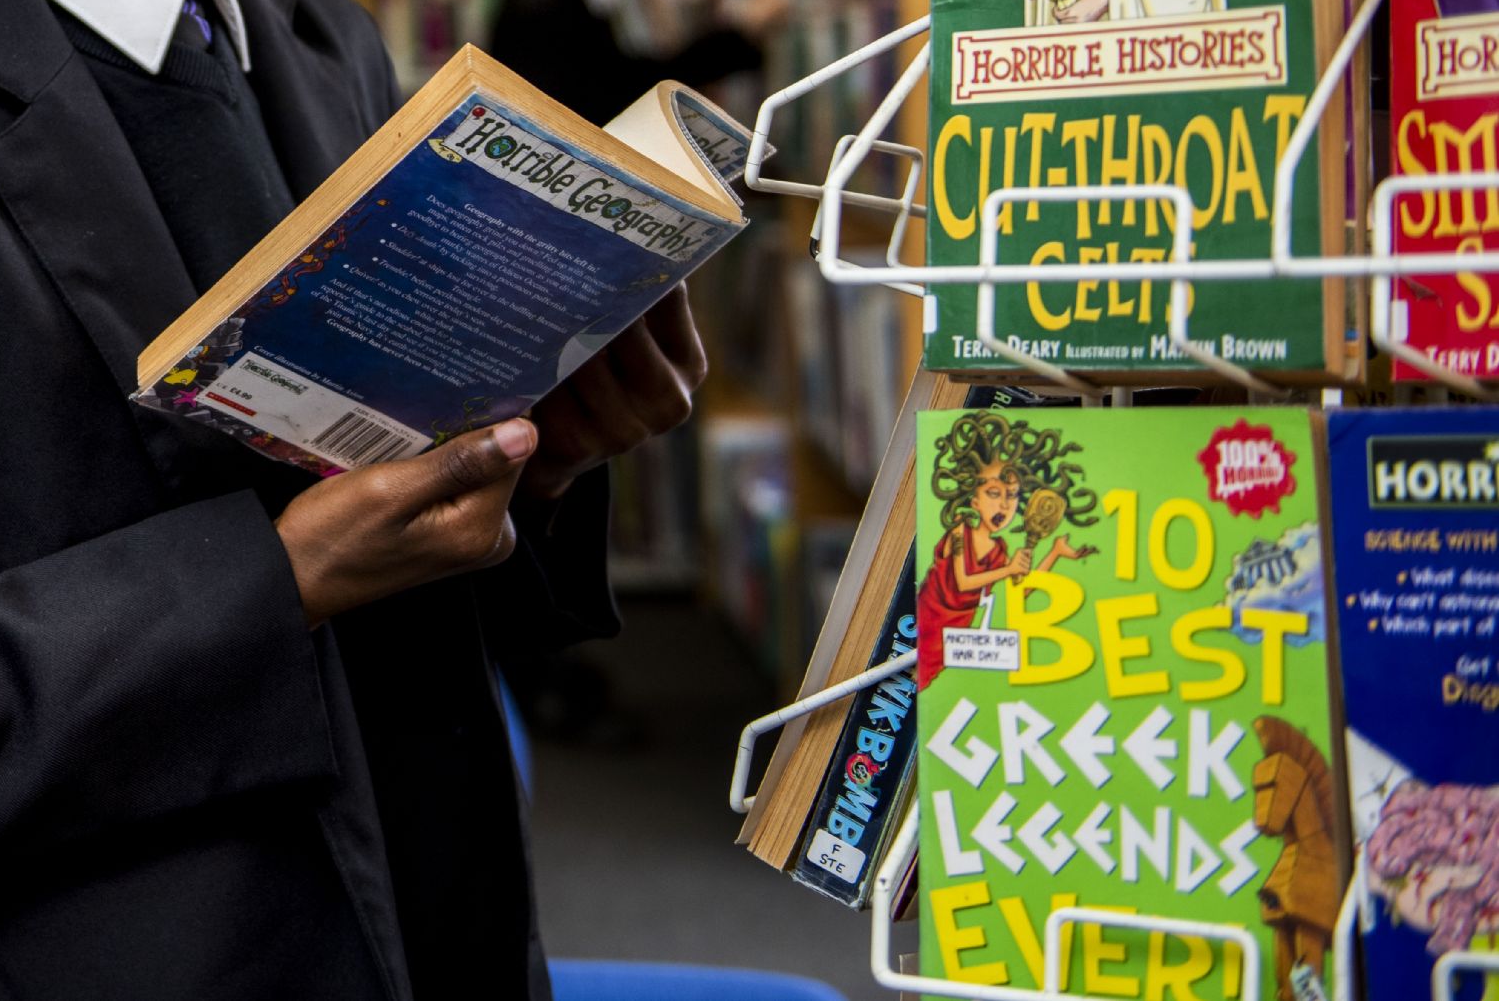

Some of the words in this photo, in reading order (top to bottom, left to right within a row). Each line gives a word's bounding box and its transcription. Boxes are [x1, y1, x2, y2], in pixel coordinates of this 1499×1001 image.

[971, 42, 1103, 84] HORRIBLE
[1116, 29, 1266, 74] HISTORIES
[933, 95, 1306, 240] CUT-THROAT
[455, 117, 575, 194] Horrible
[567, 177, 702, 257] Geography
[423, 194, 448, 209] Does
[444, 205, 486, 228] geography
[462, 203, 507, 227] Geography
[504, 224, 526, 237] with
[1455, 236, 1499, 331] S
[953, 336, 1000, 358] TER
[1008, 335, 1061, 359] DEARY
[1066, 343, 1129, 360] ILLUSTRATED
[1221, 335, 1287, 360] BROWN
[1216, 439, 1280, 469] 100%
[1375, 460, 1499, 500] HORR
[1102, 487, 1216, 592] 10
[1446, 530, 1497, 554] WITH
[1359, 590, 1394, 613] Why
[945, 633, 991, 646] ANOTHER
[995, 634, 1017, 647] BAD
[1006, 569, 1310, 707] BEST
[1382, 614, 1431, 636] Which
[1433, 616, 1471, 640] part
[1475, 616, 1496, 636] of
[952, 648, 974, 661] HAIR
[925, 697, 1247, 803] GREEK
[831, 844, 842, 854] F
[932, 789, 1263, 898] LEGENDS
[819, 853, 846, 874] STE
[929, 880, 1249, 1001] EVER!
